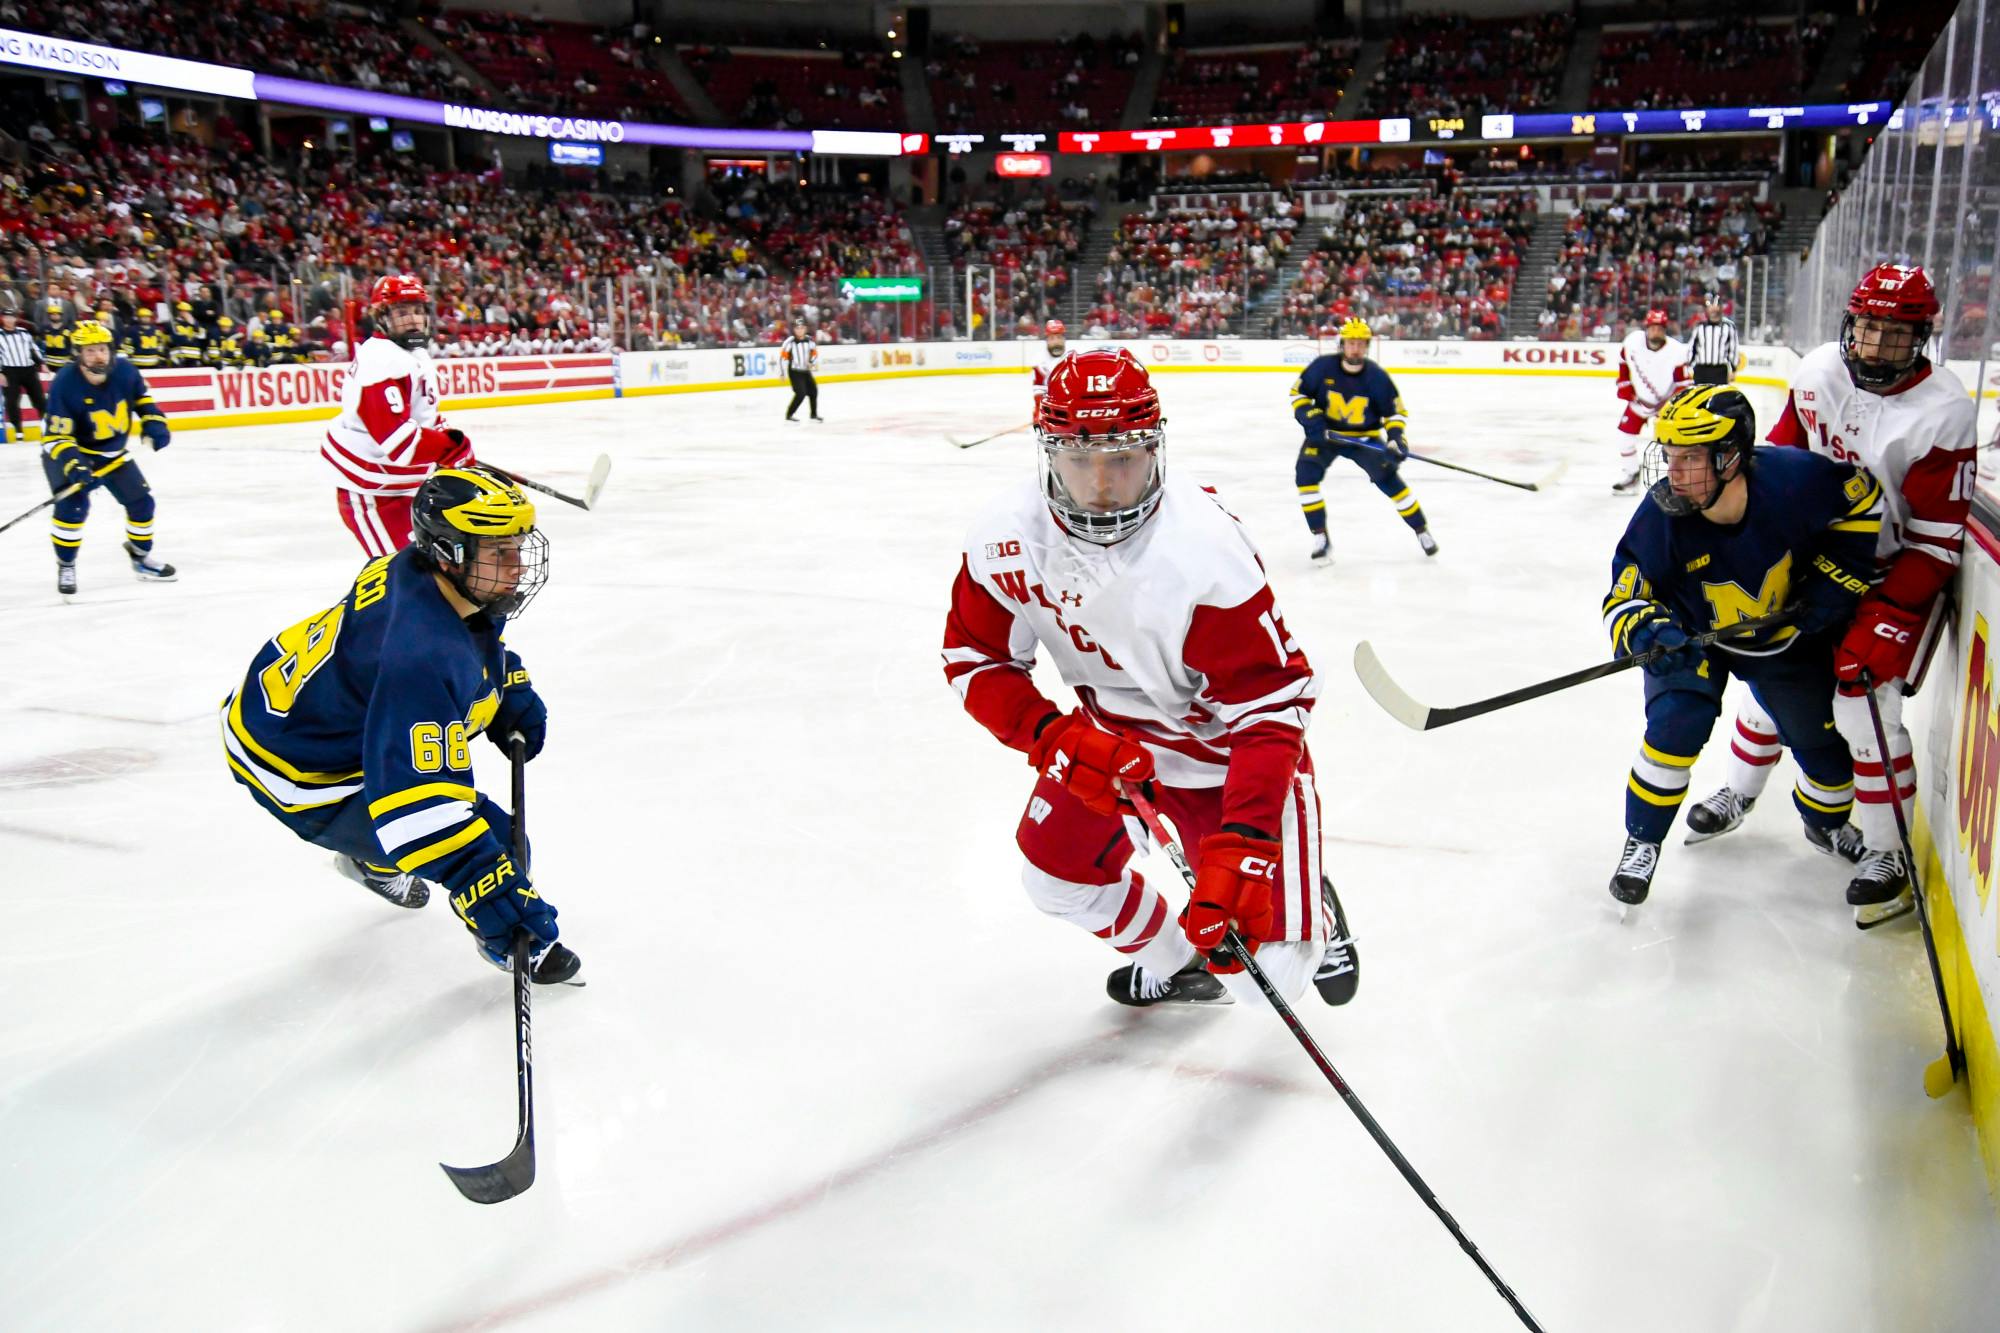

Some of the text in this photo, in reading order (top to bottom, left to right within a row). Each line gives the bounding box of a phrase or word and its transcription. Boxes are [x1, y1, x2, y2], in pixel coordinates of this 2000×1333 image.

[28, 41, 119, 71] MADISON
[1571, 115, 1596, 134] M
[1867, 298, 1897, 308] CCM
[1503, 347, 1607, 366] KOHL'S
[217, 370, 344, 408] WISCONS
[436, 362, 495, 395] GERS
[1086, 375, 1108, 392] 13
[384, 386, 405, 414] 9
[1327, 390, 1370, 425] M
[90, 399, 129, 440] M
[1075, 408, 1121, 429] CCM
[1702, 549, 1793, 638] M
[1874, 622, 1910, 643] CC
[410, 721, 472, 774] 68
[1119, 757, 1141, 774] CCM
[1239, 856, 1276, 880] CC
[1200, 920, 1224, 935] CCM
